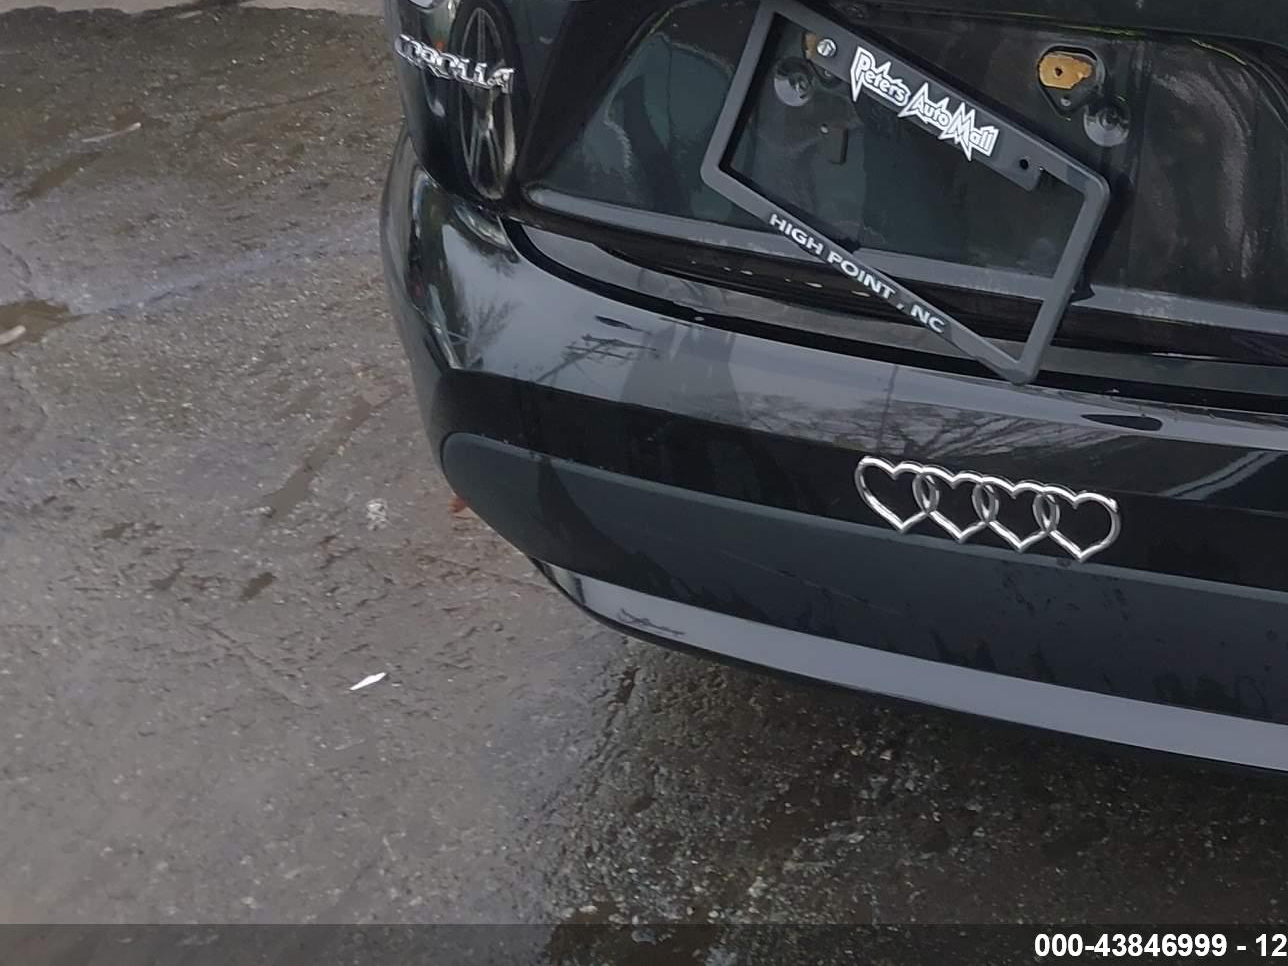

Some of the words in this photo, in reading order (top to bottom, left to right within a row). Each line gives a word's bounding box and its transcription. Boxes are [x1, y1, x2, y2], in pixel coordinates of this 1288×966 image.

[850, 46, 911, 103] Peters
[898, 82, 953, 132] Auto
[937, 102, 999, 161] Mall
[769, 213, 824, 256] HIGH
[910, 304, 946, 334] NC
